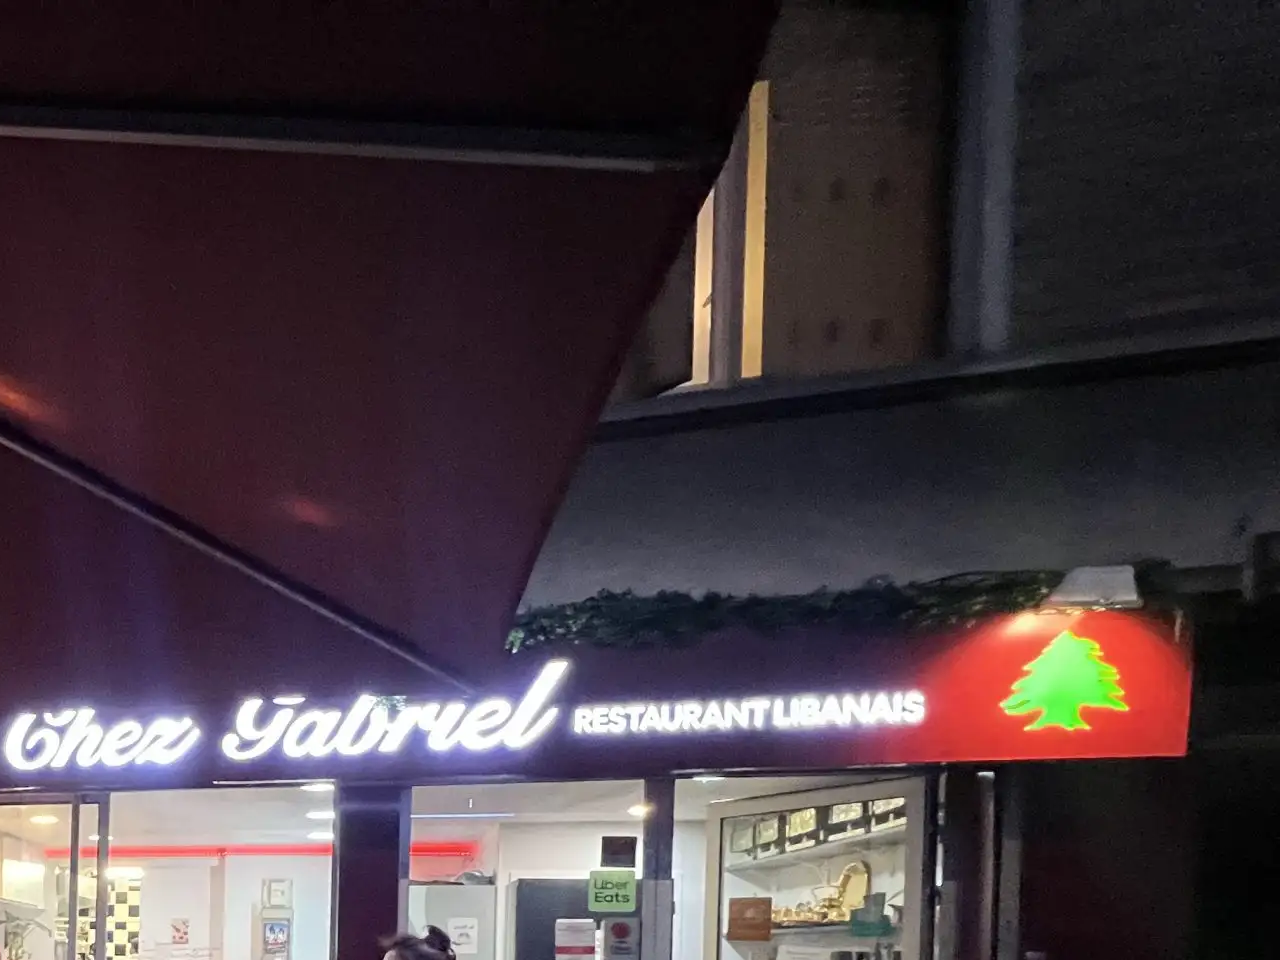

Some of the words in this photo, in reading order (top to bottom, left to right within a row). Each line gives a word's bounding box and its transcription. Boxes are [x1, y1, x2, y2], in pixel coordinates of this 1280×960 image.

[3, 706, 201, 771] Chez
[221, 659, 570, 761] Gabriel
[573, 698, 771, 734] RESTAURANT
[773, 689, 925, 729] LIBANAIS
[593, 878, 630, 890] Uber
[594, 891, 631, 904] Eats
